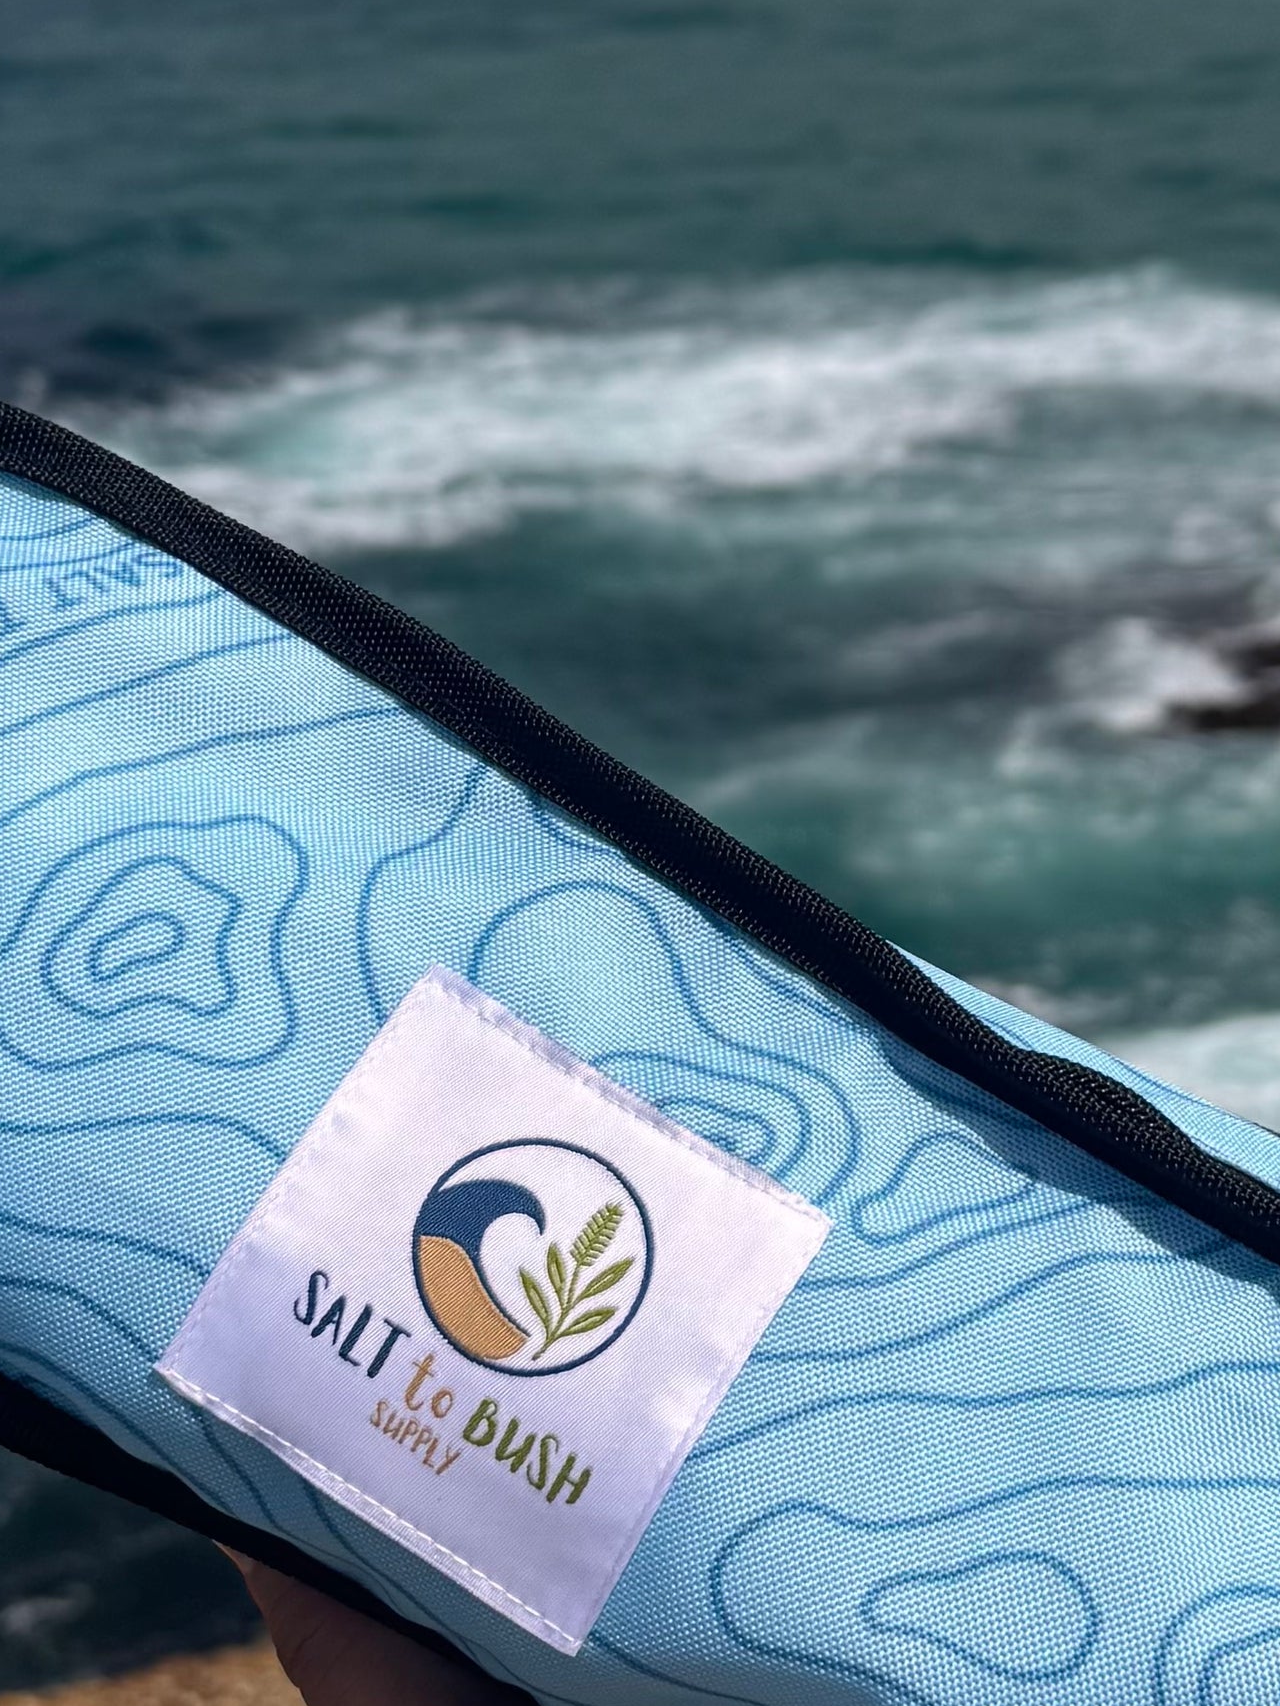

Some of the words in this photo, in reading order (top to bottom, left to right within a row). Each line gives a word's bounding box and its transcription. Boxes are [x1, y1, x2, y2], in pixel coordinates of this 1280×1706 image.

[48, 550, 183, 613] SALT
[293, 1270, 412, 1378] SALT
[404, 1353, 455, 1419] to
[462, 1398, 592, 1506] BUSH
[369, 1400, 461, 1475] SUPPLY
